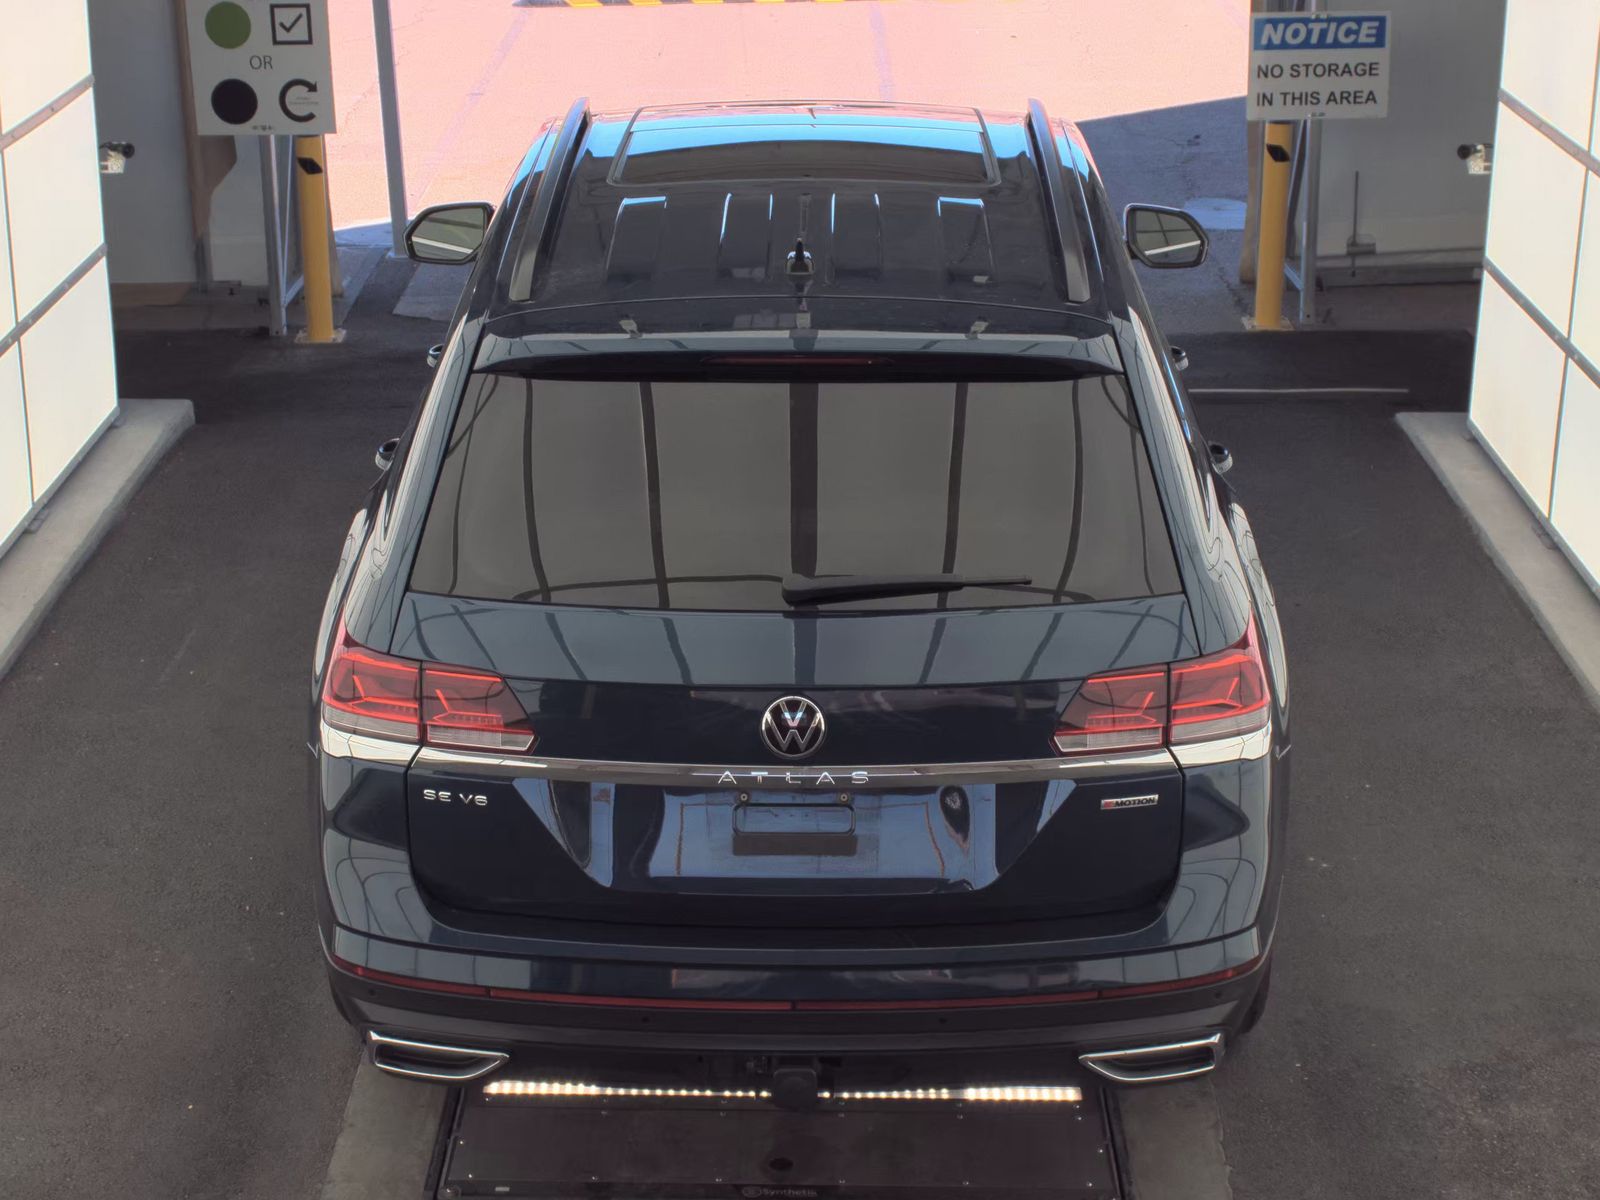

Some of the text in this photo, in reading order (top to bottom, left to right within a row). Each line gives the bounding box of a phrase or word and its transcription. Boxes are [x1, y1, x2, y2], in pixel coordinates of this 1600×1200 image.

[1260, 21, 1380, 45] NOTICE
[250, 55, 273, 70] OR
[1257, 62, 1380, 79] NO STORAGE
[1256, 90, 1378, 107] IN THIS AREA
[717, 770, 869, 785] ATLAS
[423, 789, 488, 806] SE V6
[1103, 797, 1156, 809] MOTION
